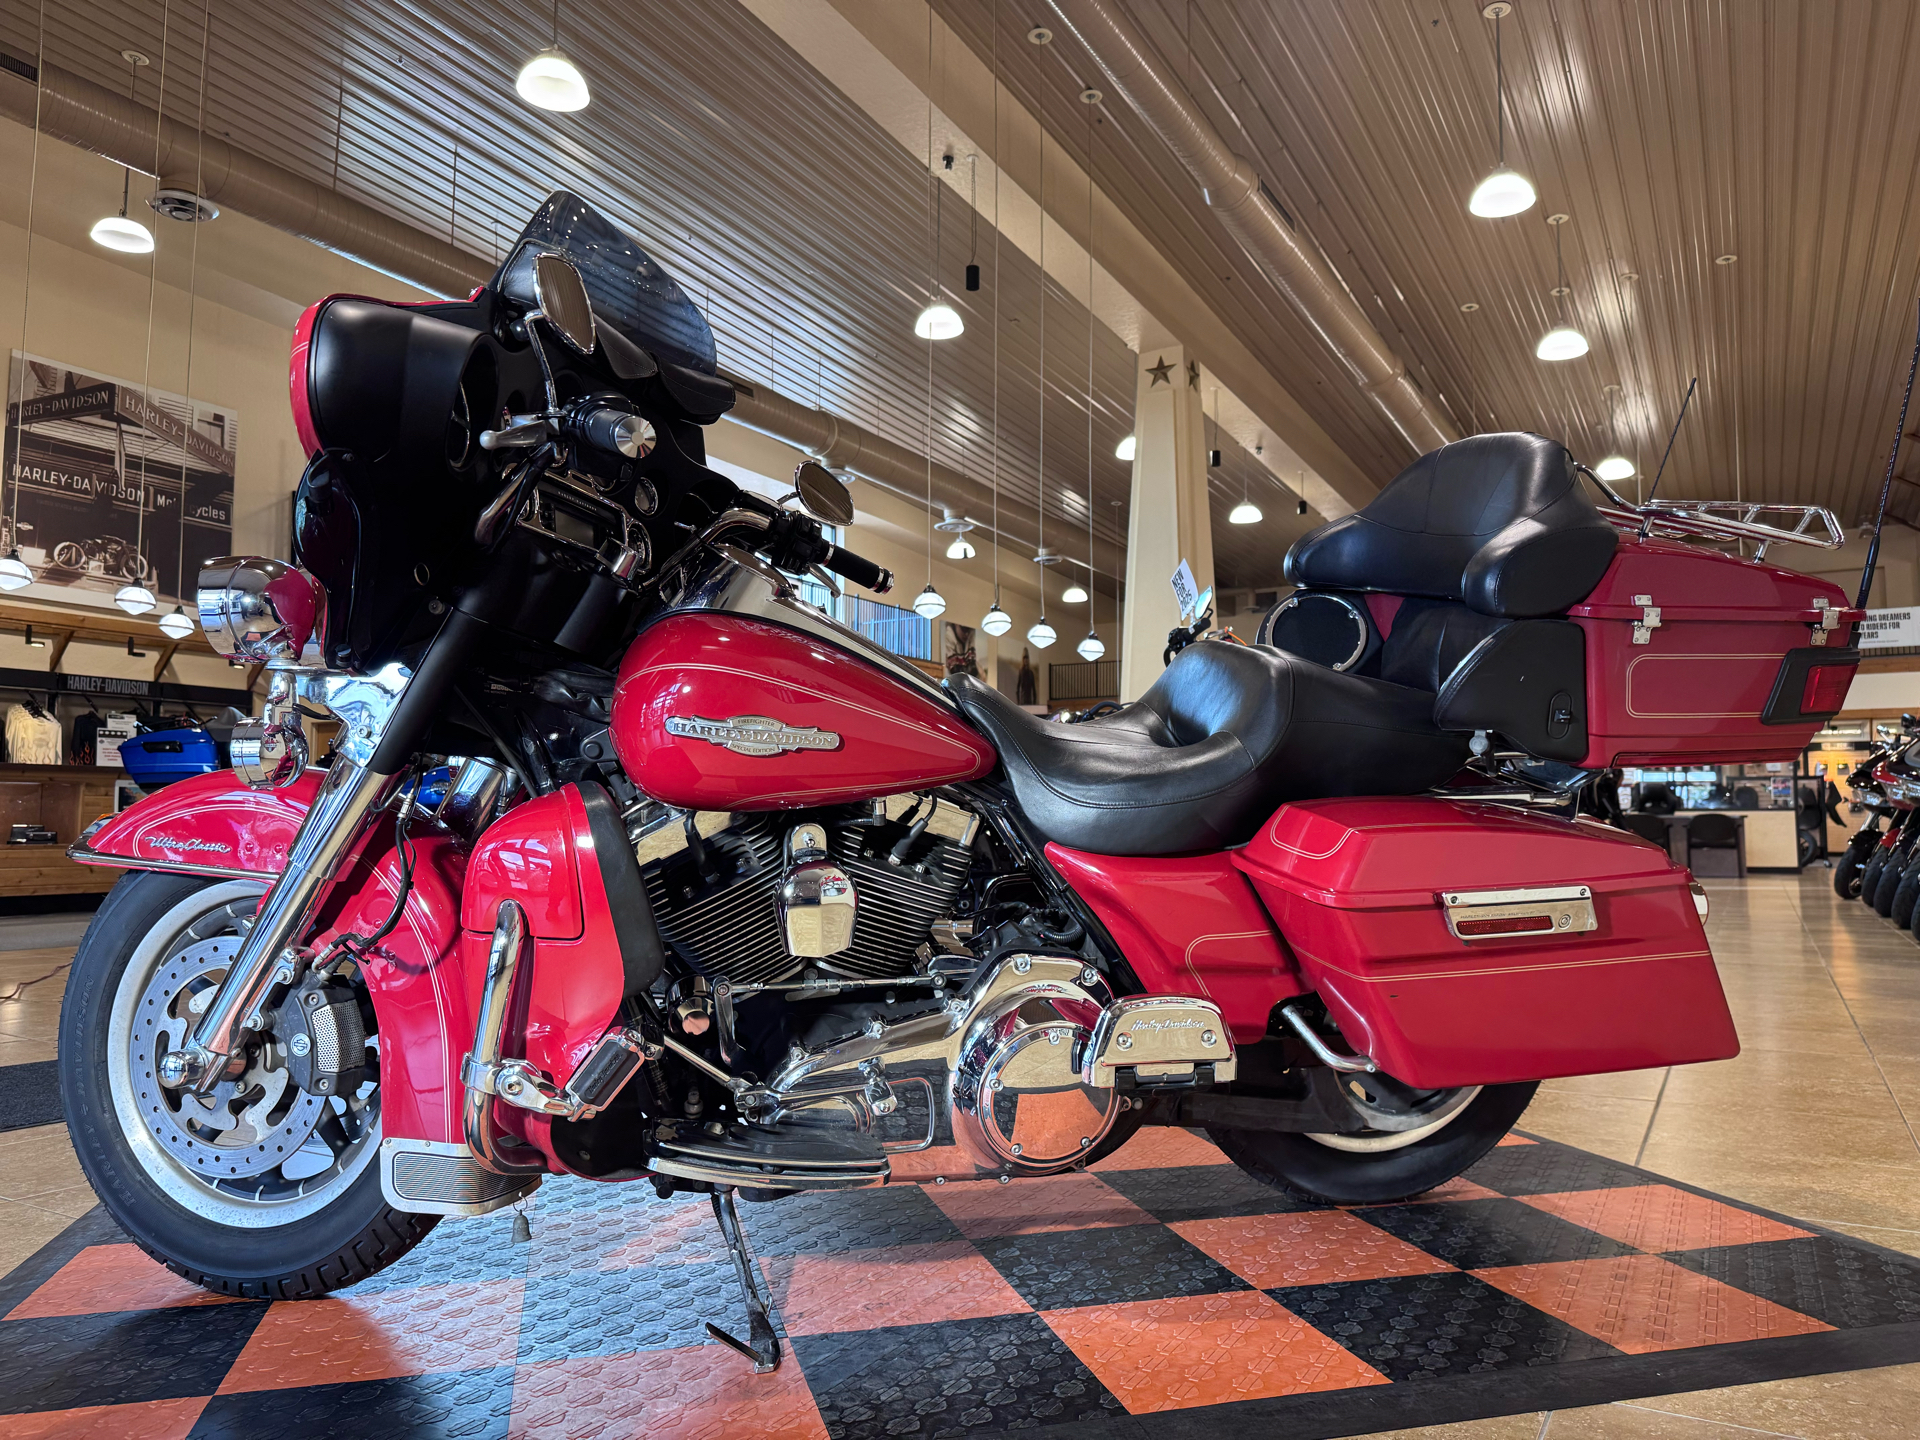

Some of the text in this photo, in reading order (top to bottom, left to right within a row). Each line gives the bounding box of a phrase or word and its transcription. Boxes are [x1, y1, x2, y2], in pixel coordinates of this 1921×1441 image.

[10, 390, 109, 419] HRLEY-DAVIDSON
[12, 464, 145, 502] HARLEY-DAVIDSON
[1171, 568, 1184, 590] NEW
[1176, 583, 1187, 601] FOR
[1866, 622, 1888, 631] RIDERS
[1888, 621, 1900, 630] FOR
[1878, 612, 1911, 622] DREAMERS
[67, 675, 149, 696] HARLEY-DAVIDSON
[737, 717, 775, 728] FIREFIGHTER
[673, 722, 833, 746] HARLEY-DAVIDSON
[731, 743, 776, 754] SPECIAL EDITION
